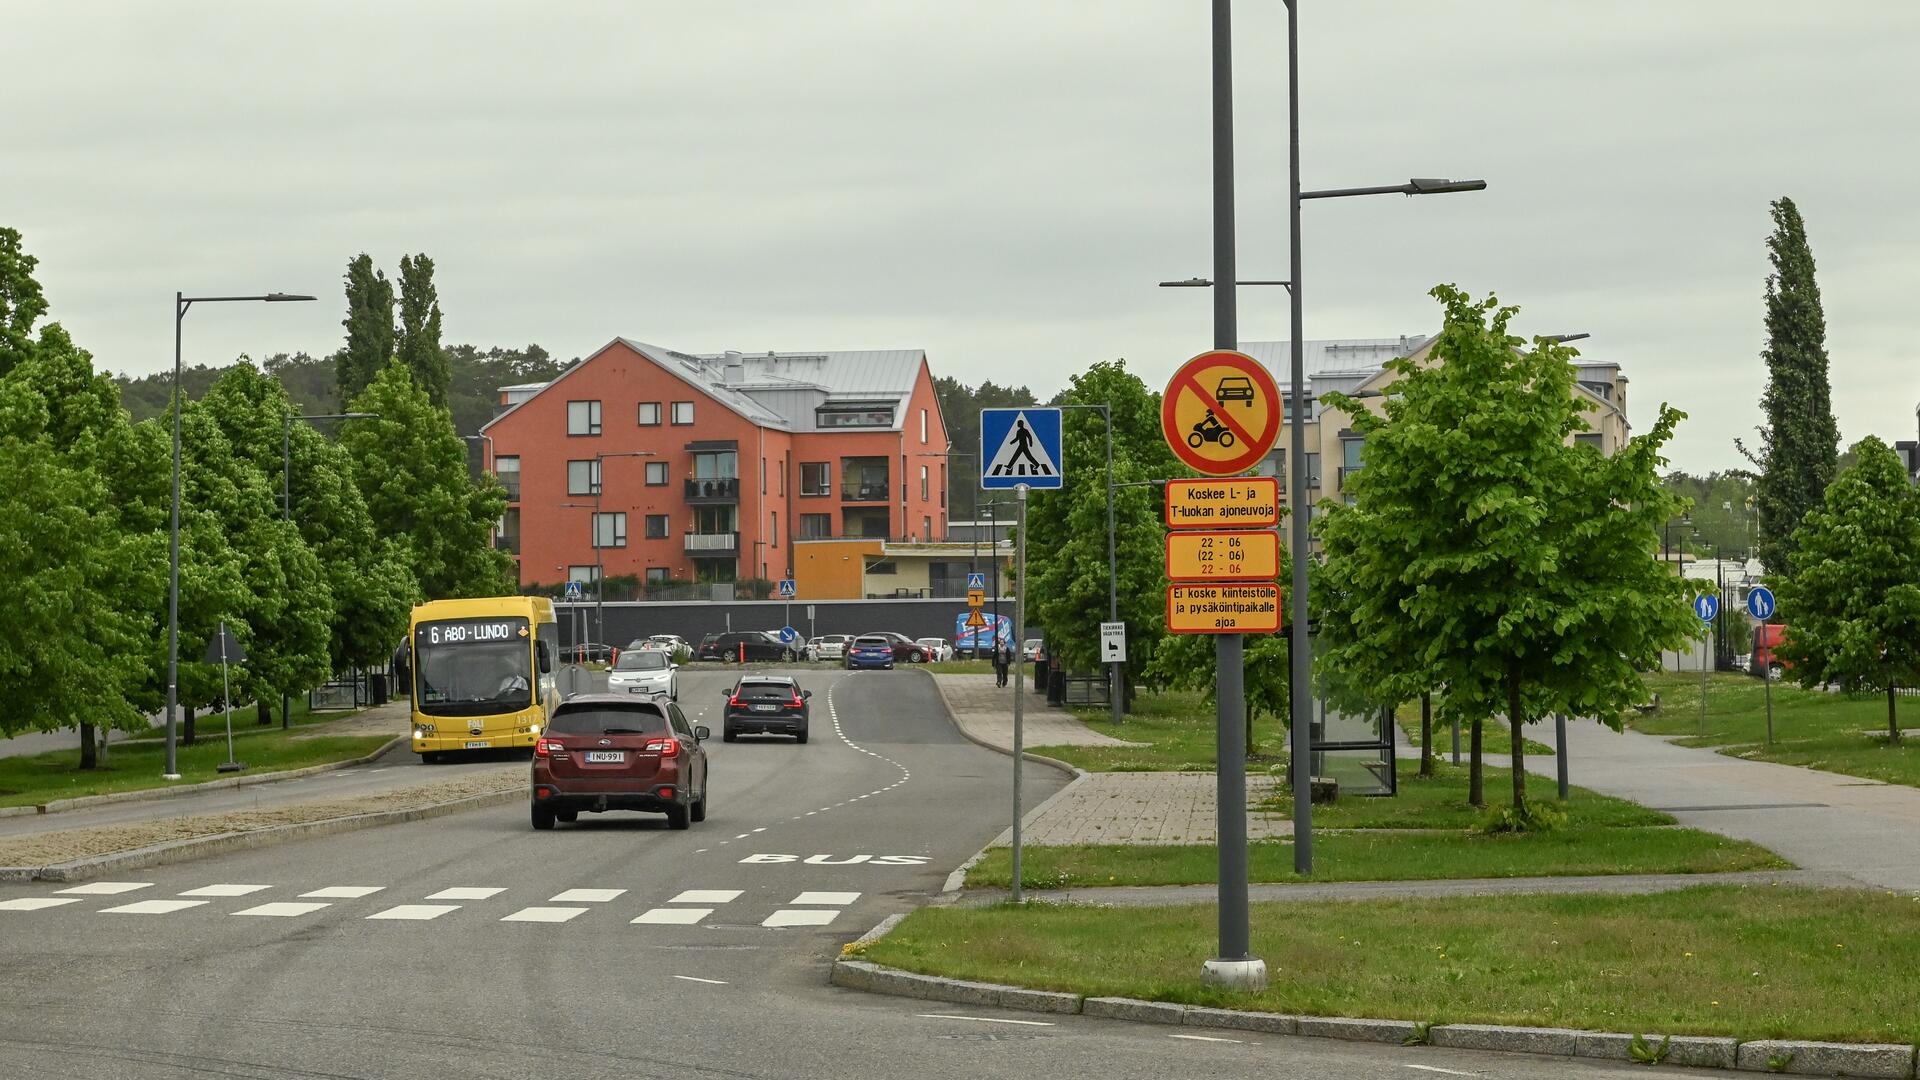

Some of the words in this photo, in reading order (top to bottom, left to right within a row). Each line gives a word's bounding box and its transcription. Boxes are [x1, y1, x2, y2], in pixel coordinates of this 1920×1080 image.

[1188, 488, 1225, 500] Koskee
[1230, 487, 1241, 499] L-
[1246, 487, 1256, 500] ja
[1171, 505, 1214, 517] T-luokan
[1219, 504, 1274, 518] ajoneuvoja
[1201, 537, 1213, 548] 22
[1229, 537, 1241, 547] 06
[1198, 550, 1213, 562] (22
[1229, 550, 1245, 562] 06)
[1201, 564, 1214, 574] 22
[1229, 564, 1241, 574] 06
[1174, 588, 1183, 598] Ei
[1188, 588, 1216, 598] koske
[1222, 587, 1276, 598] kiinteistölle
[1176, 602, 1185, 614] ja
[1190, 602, 1275, 614] pysäköintipaikalle
[1215, 617, 1235, 629] ajoa
[431, 626, 439, 643] 6
[444, 627, 466, 642] ÅBO
[474, 624, 509, 640] LUNDO
[592, 751, 621, 760] INU-991
[737, 853, 934, 865] BUS
